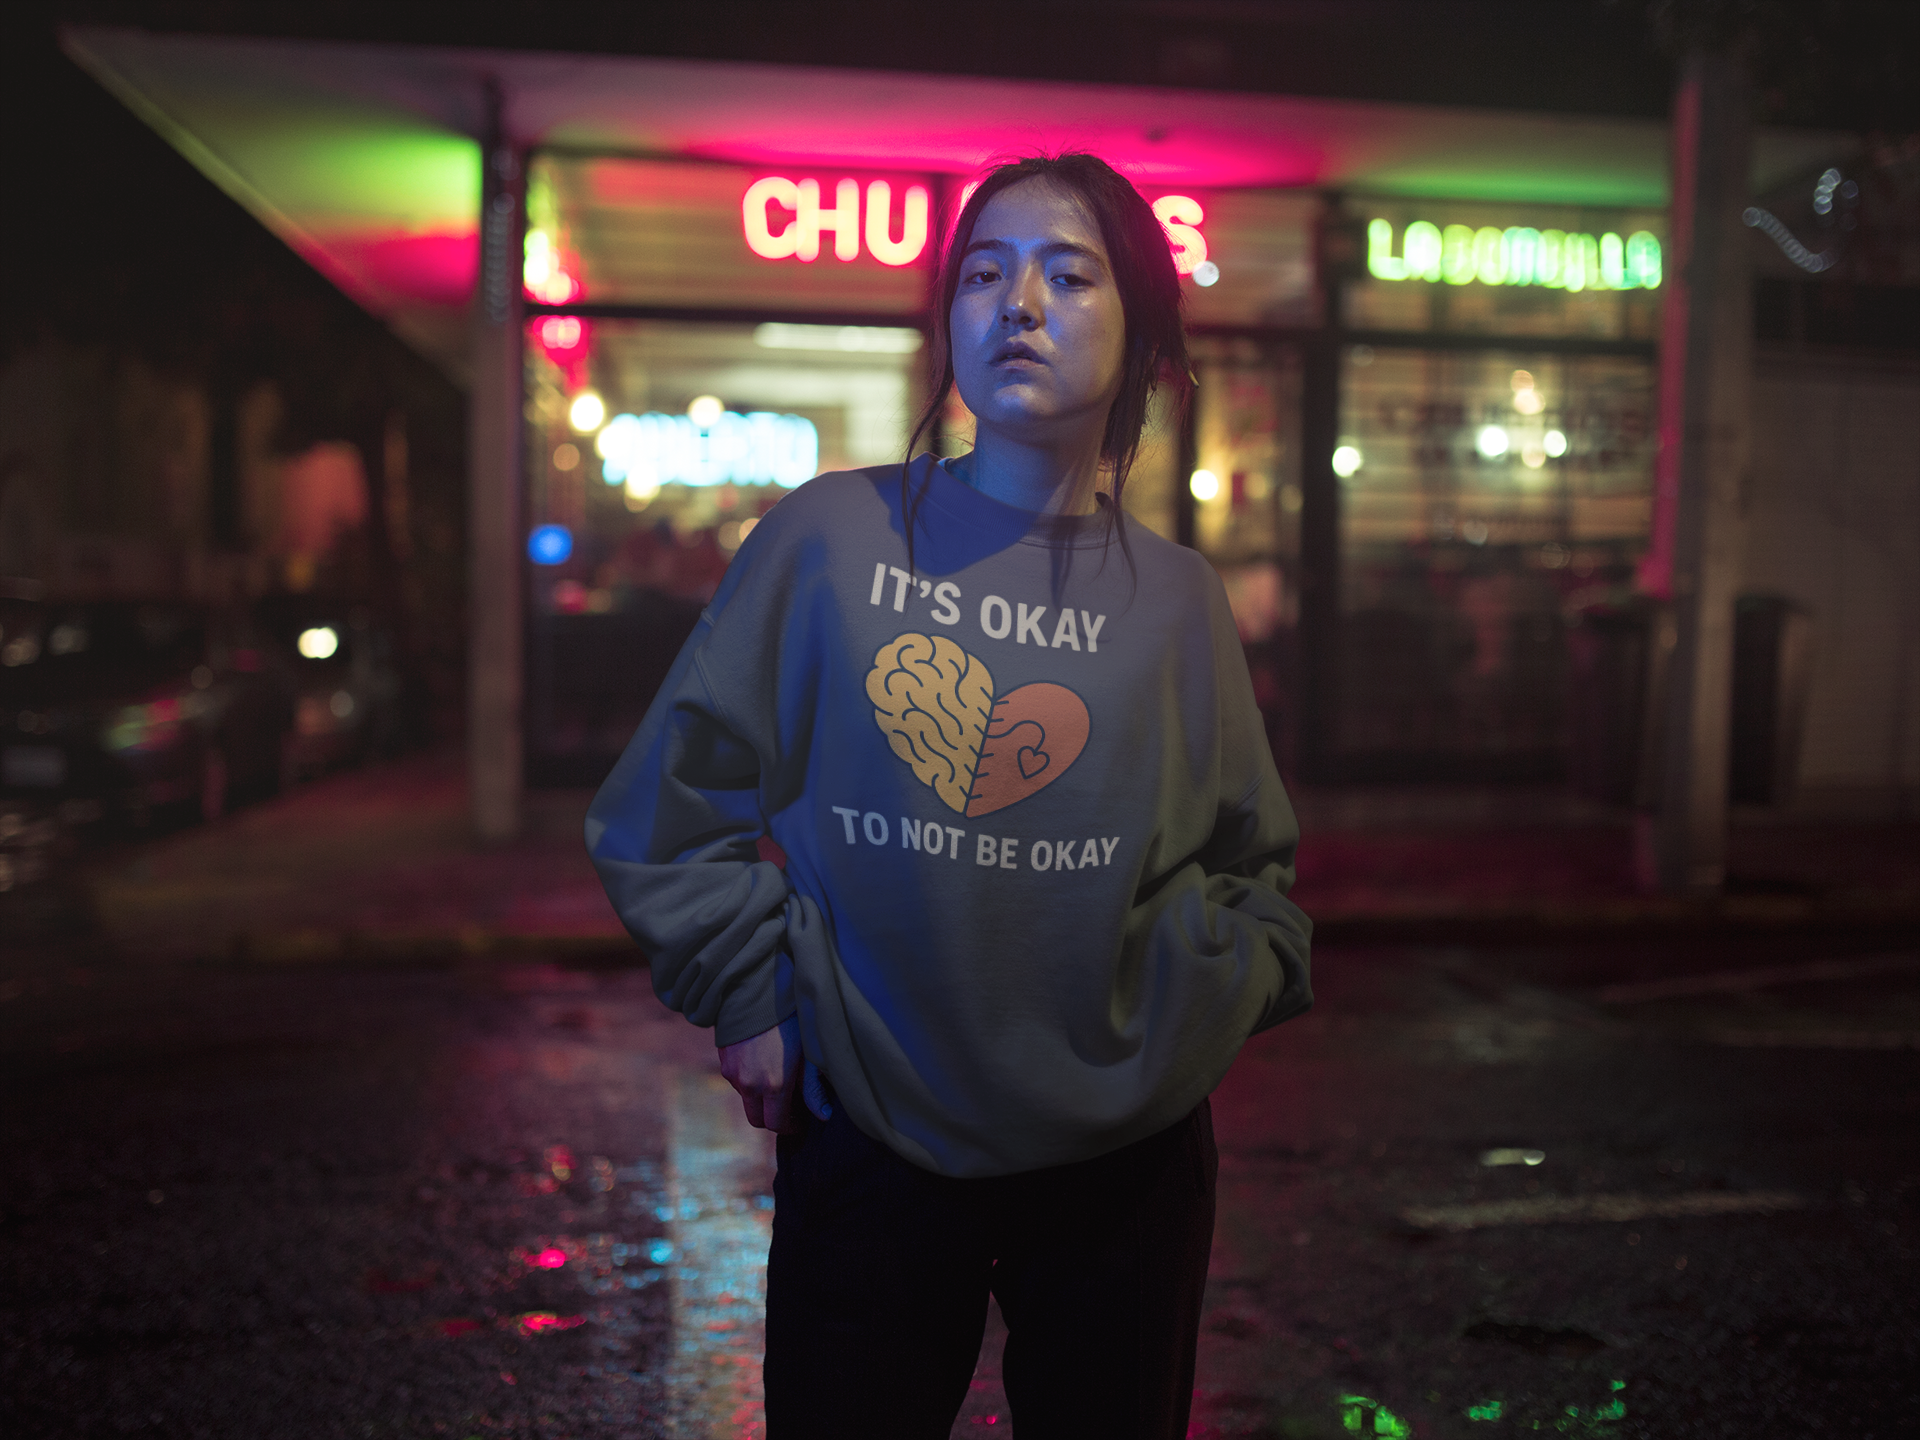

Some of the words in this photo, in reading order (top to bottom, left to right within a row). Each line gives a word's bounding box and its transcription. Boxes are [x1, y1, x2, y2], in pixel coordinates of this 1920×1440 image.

[870, 562, 962, 626] IT'S
[980, 594, 1107, 653] OKAY
[832, 805, 890, 846] TO
[900, 816, 966, 860] NOT
[976, 833, 1019, 870] BE
[1030, 836, 1121, 872] OKAY
